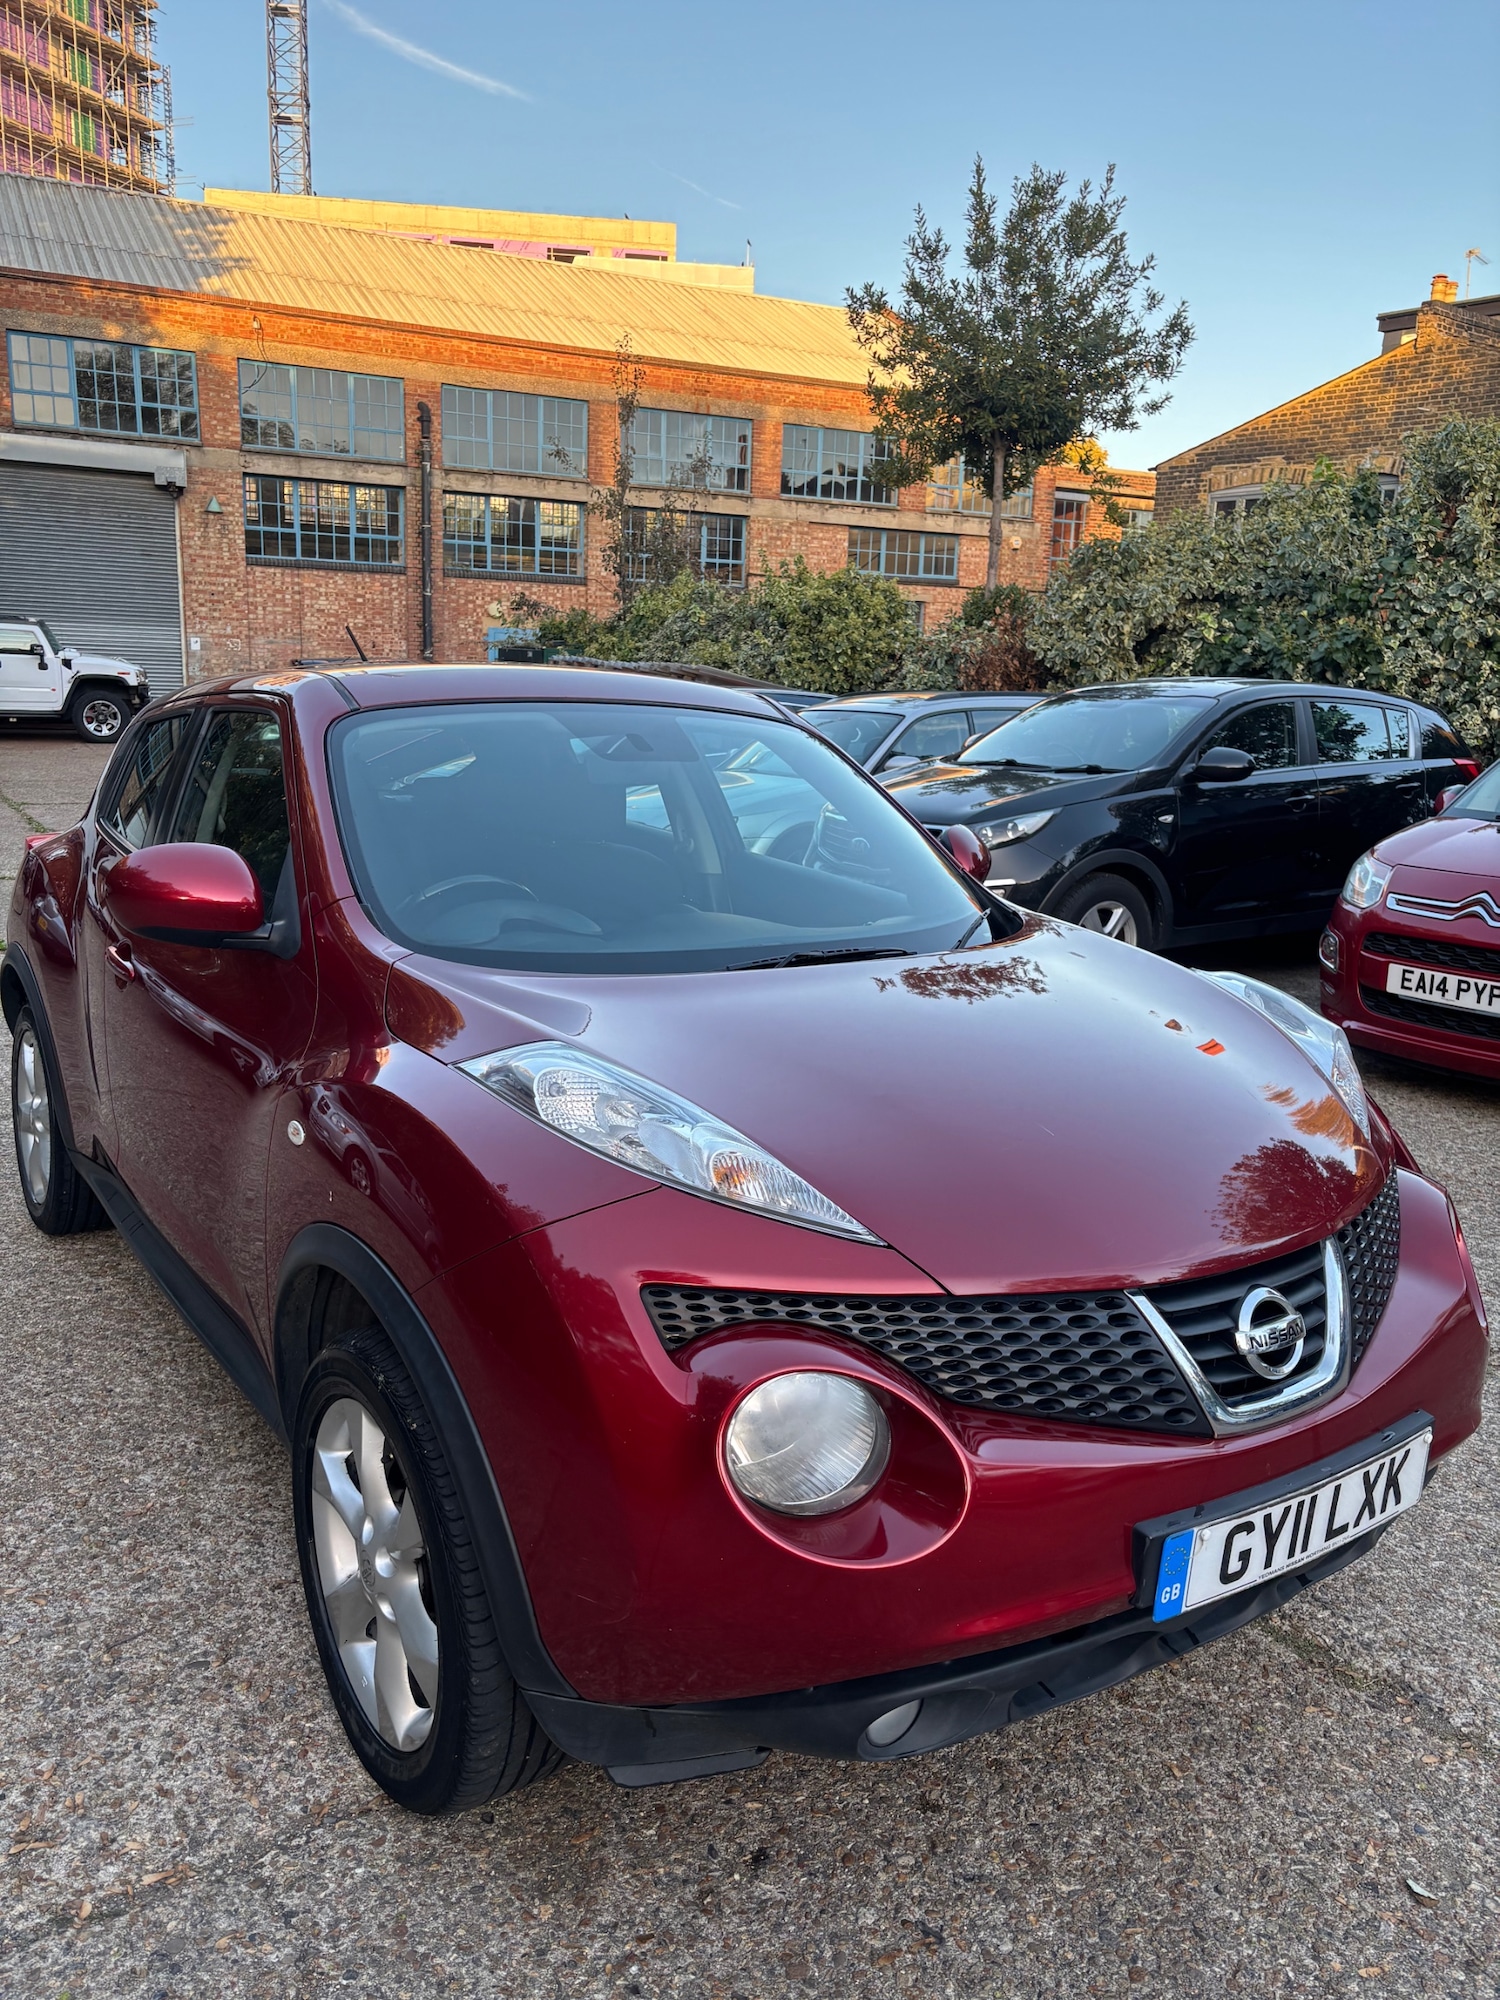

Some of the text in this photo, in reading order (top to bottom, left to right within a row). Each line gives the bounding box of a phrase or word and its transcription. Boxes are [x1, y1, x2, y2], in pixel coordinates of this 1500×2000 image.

[1400, 968, 1449, 998] EA14
[1249, 1321, 1304, 1349] NISSAN
[1219, 1448, 1411, 1585] GY11 LXK
[1285, 1556, 1305, 1569] NISSAN
[1161, 1583, 1181, 1604] GB
